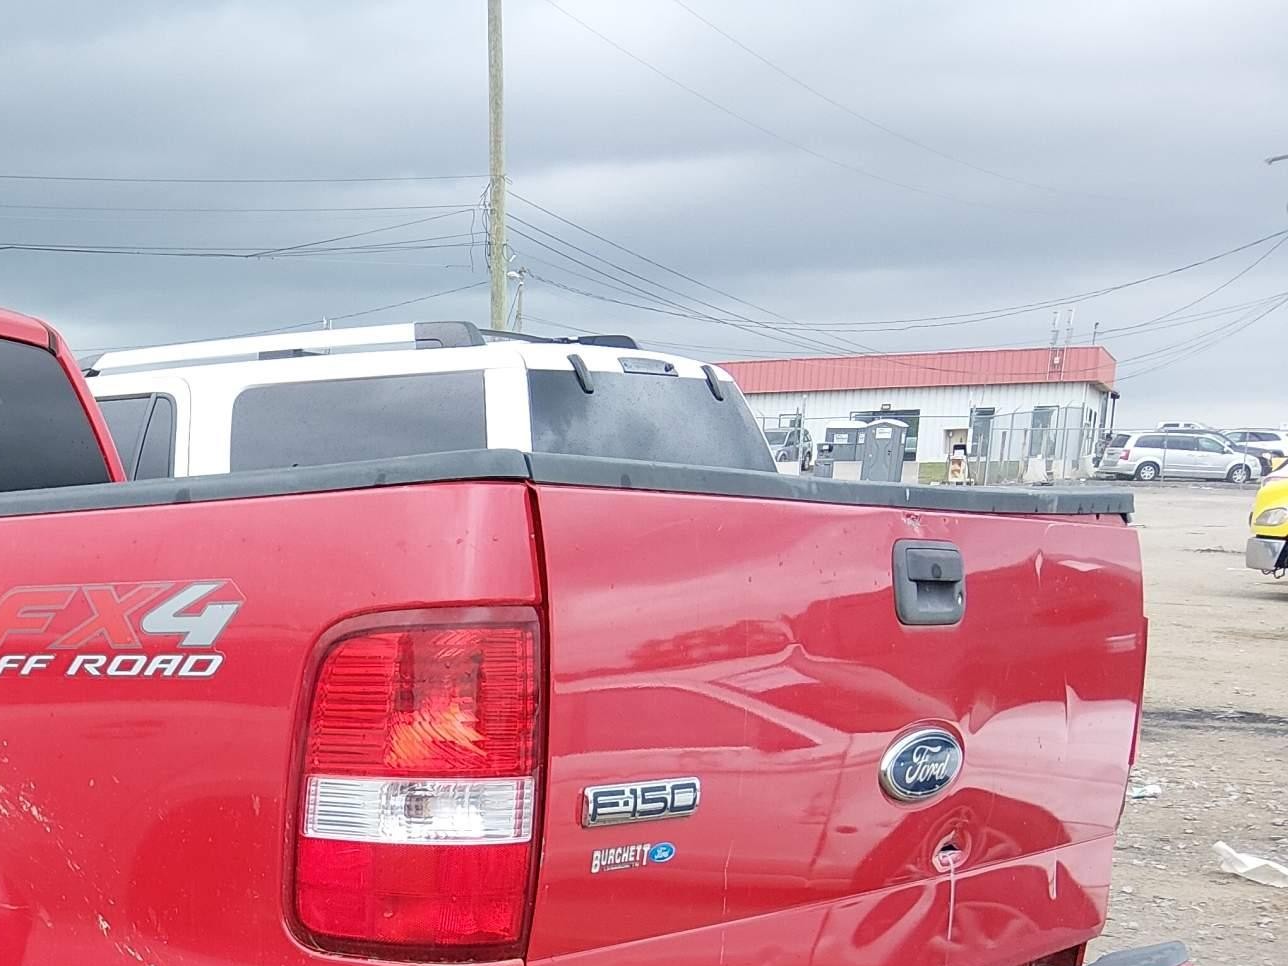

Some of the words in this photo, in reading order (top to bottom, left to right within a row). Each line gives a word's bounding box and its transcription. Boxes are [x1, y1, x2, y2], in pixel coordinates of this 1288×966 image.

[65, 654, 225, 677] ROAD
[905, 745, 951, 784] Ford
[591, 843, 651, 873] BURCHETT
